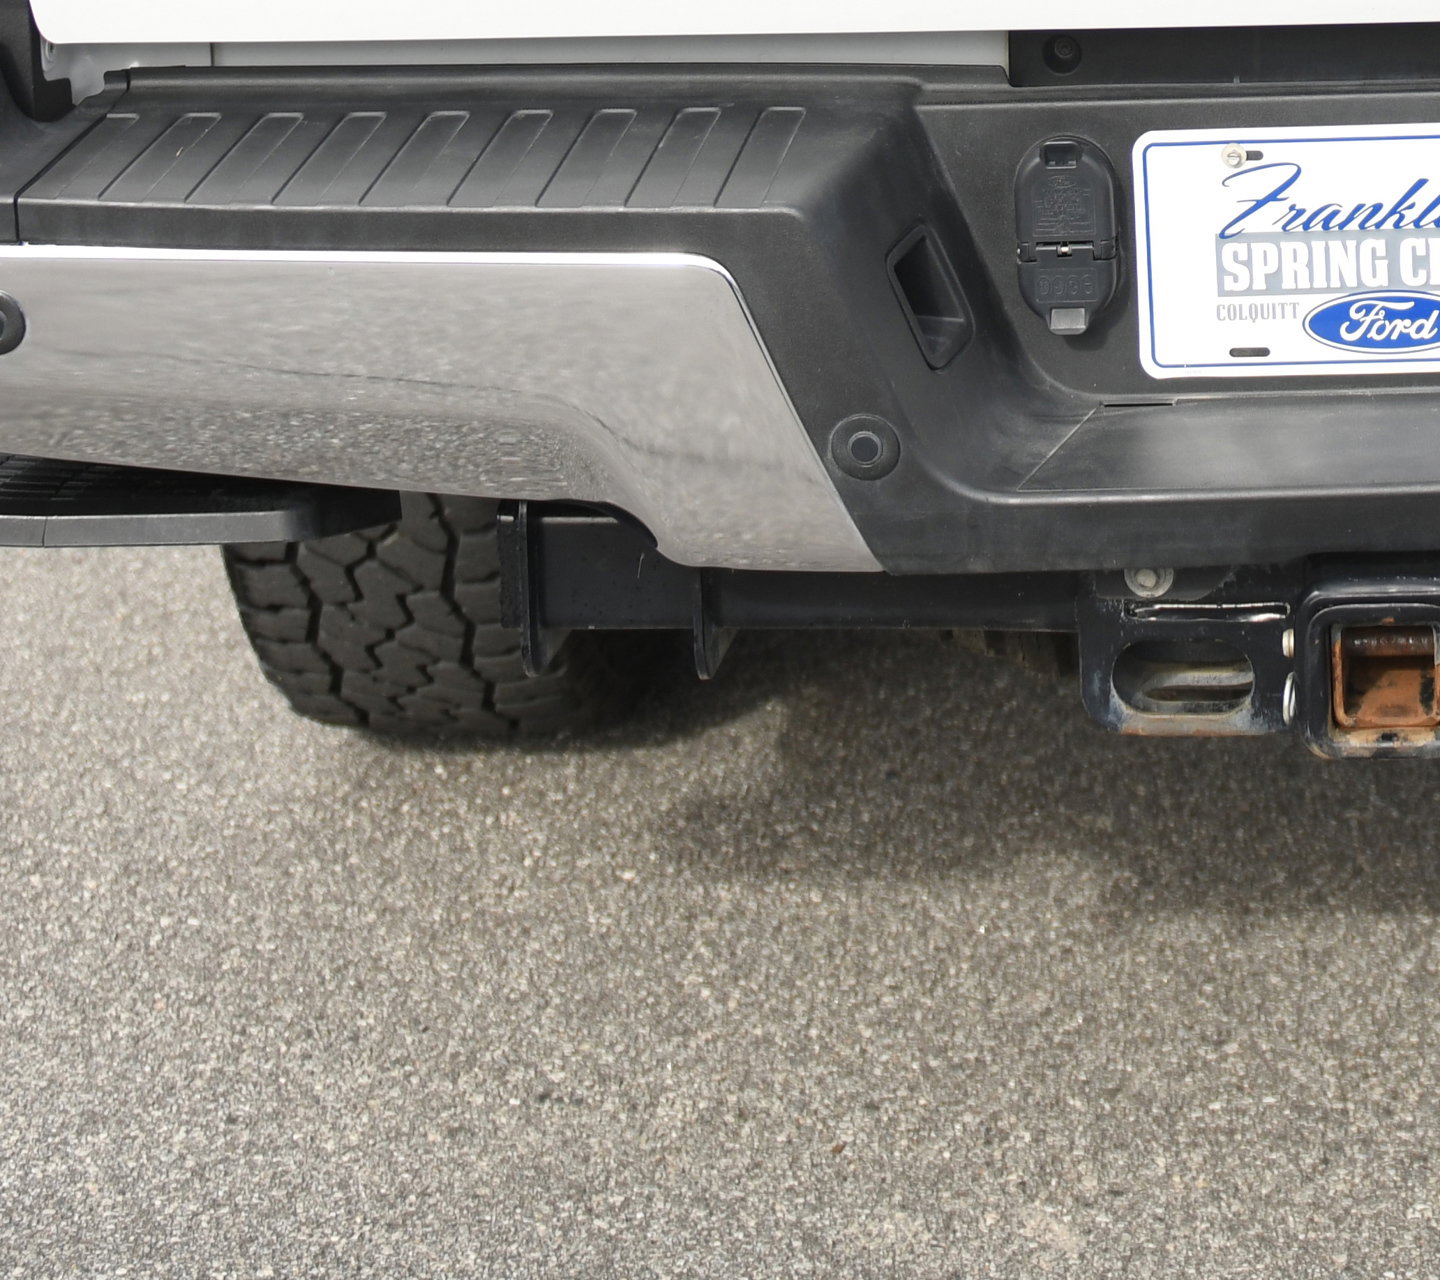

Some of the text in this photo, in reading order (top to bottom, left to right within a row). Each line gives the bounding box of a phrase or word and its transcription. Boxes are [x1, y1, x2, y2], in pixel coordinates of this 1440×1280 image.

[1221, 239, 1389, 292] SPRING
[1216, 301, 1300, 324] COLQUITT
[1339, 299, 1439, 342] Ford
